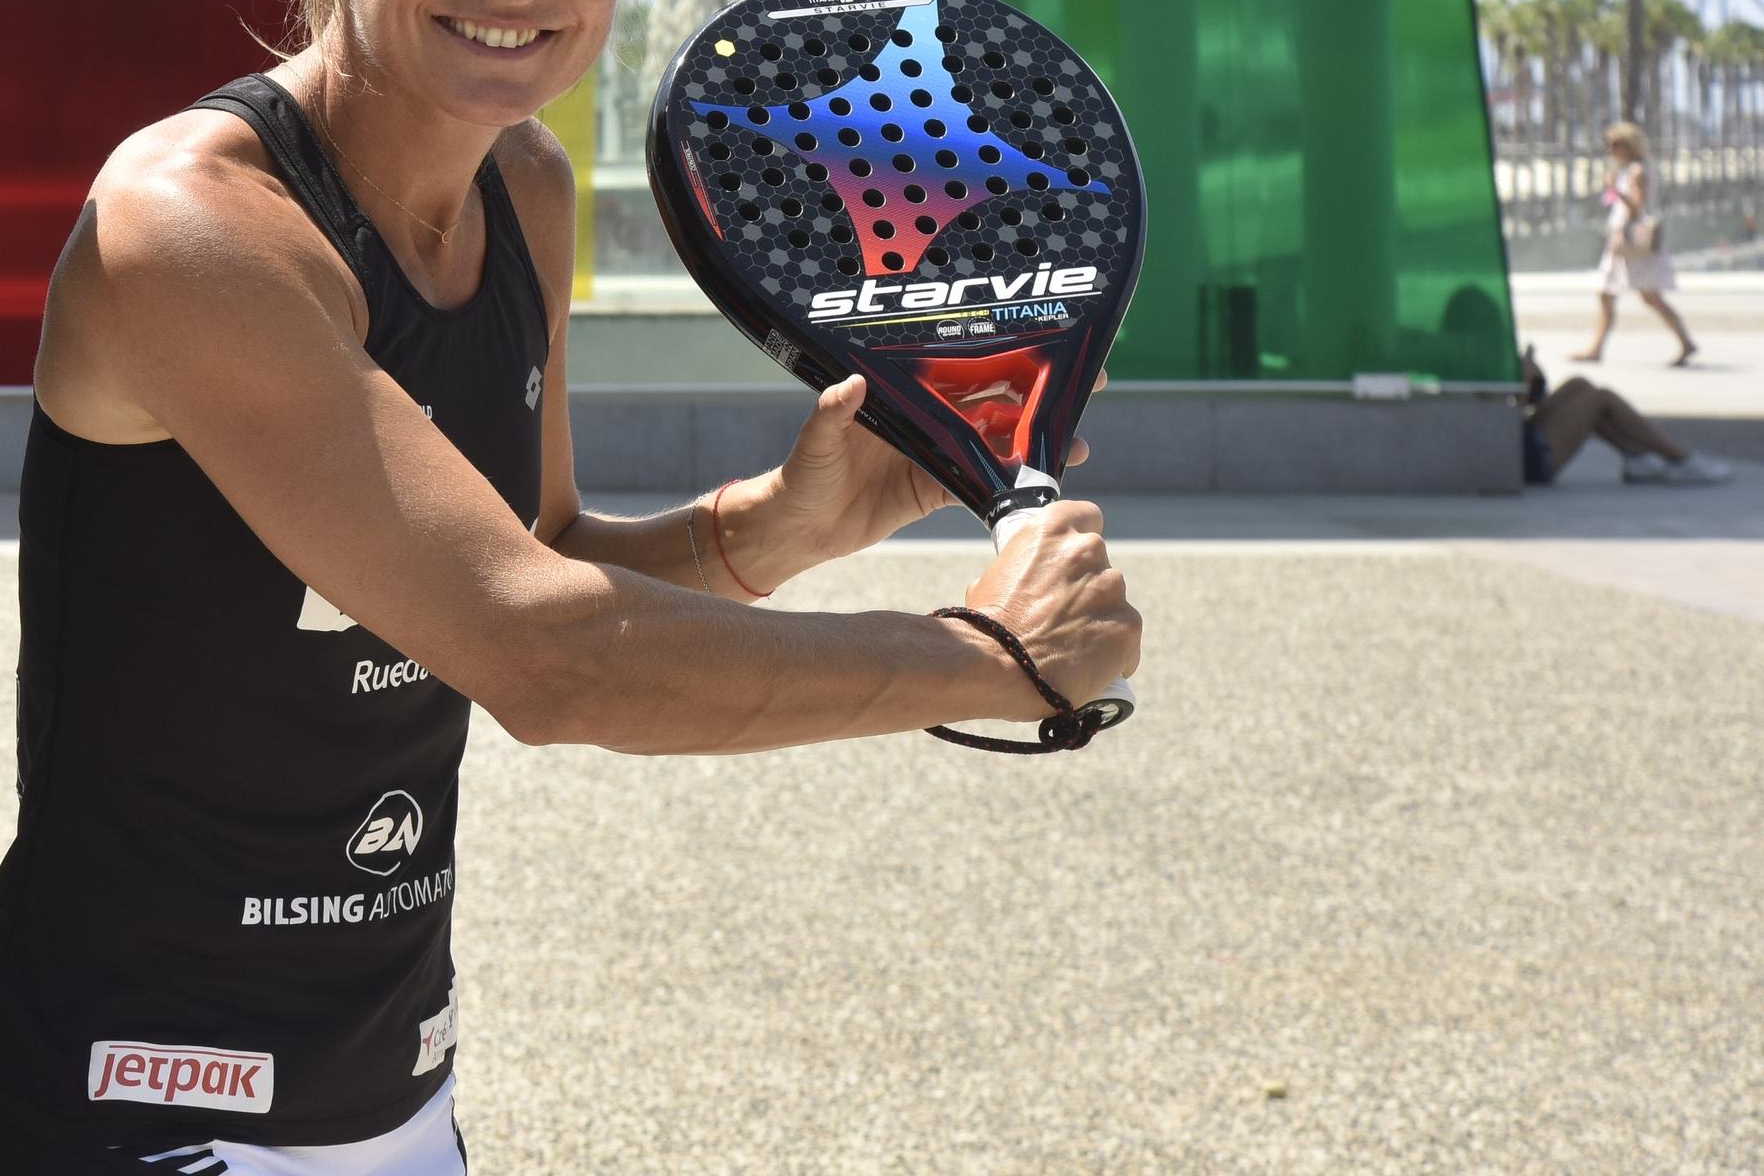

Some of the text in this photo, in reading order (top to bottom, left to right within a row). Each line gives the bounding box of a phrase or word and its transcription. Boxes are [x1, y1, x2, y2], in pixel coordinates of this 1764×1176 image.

[813, 2, 887, 14] STARVIE
[806, 261, 1099, 319] starvie
[991, 301, 1068, 323] TITANIA
[938, 325, 962, 334] ROUND
[969, 324, 996, 334] FRAME
[241, 893, 365, 926] BILSING
[94, 1050, 264, 1102] jetpak
